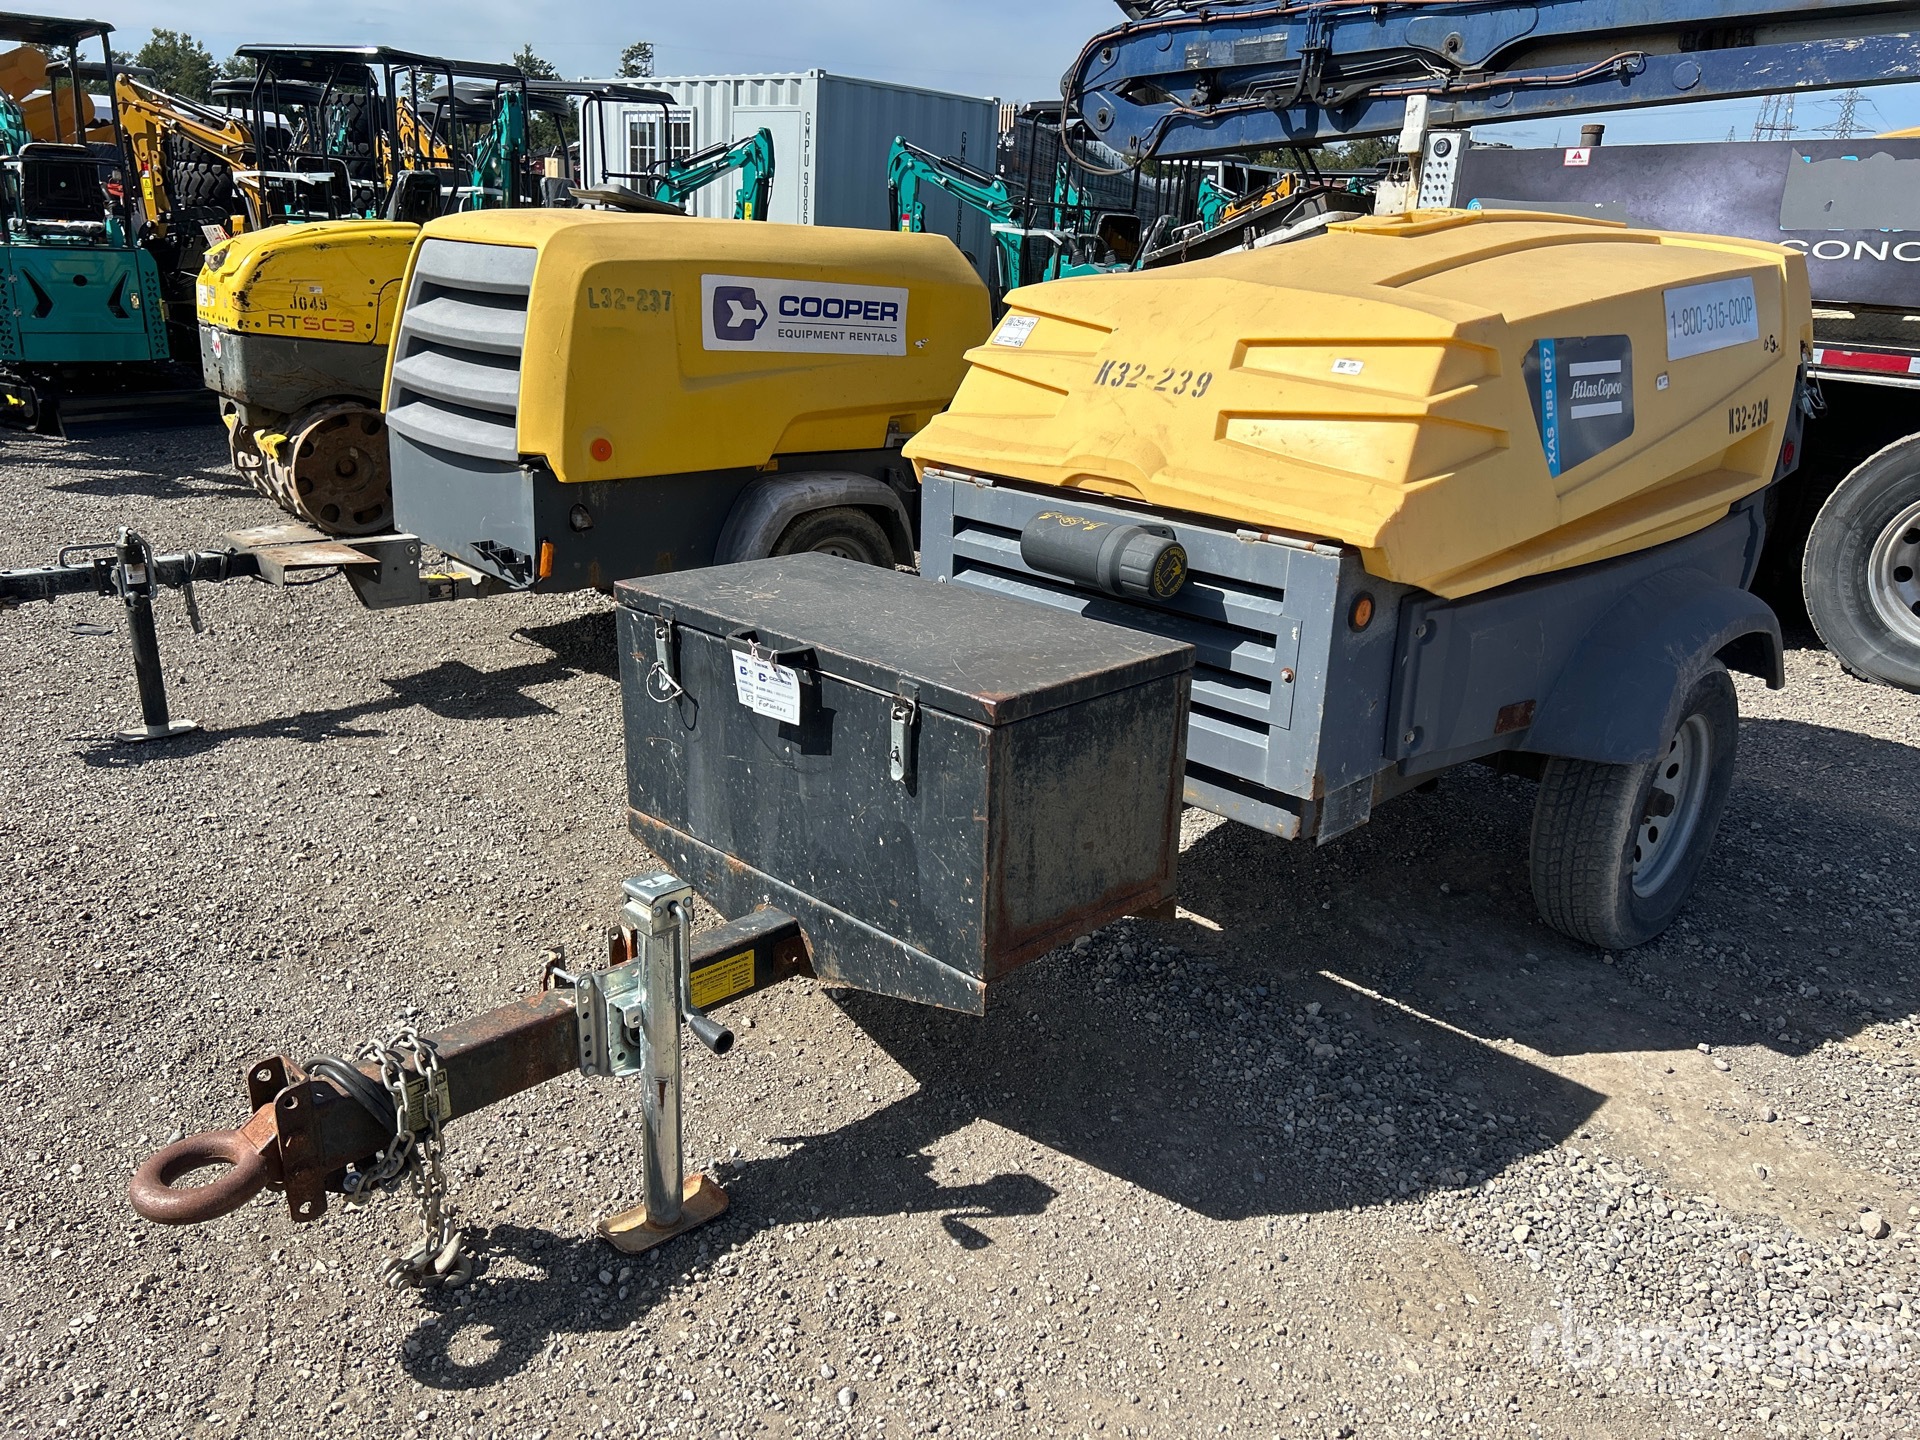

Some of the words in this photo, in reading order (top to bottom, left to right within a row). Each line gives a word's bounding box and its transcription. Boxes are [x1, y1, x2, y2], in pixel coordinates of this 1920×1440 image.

[803, 111, 811, 168] GMPU
[588, 287, 672, 313] L32-237
[778, 295, 899, 322] COOPER
[1670, 295, 1753, 339] 1-800-315-COOP
[777, 328, 846, 342] EQUIPMENT
[849, 331, 898, 343] RENTALS
[1093, 359, 1213, 398] K32-239
[1543, 347, 1553, 384] KD7
[1545, 389, 1554, 417] 185
[1728, 398, 1769, 435] K32-239
[1547, 426, 1556, 465] XAS
